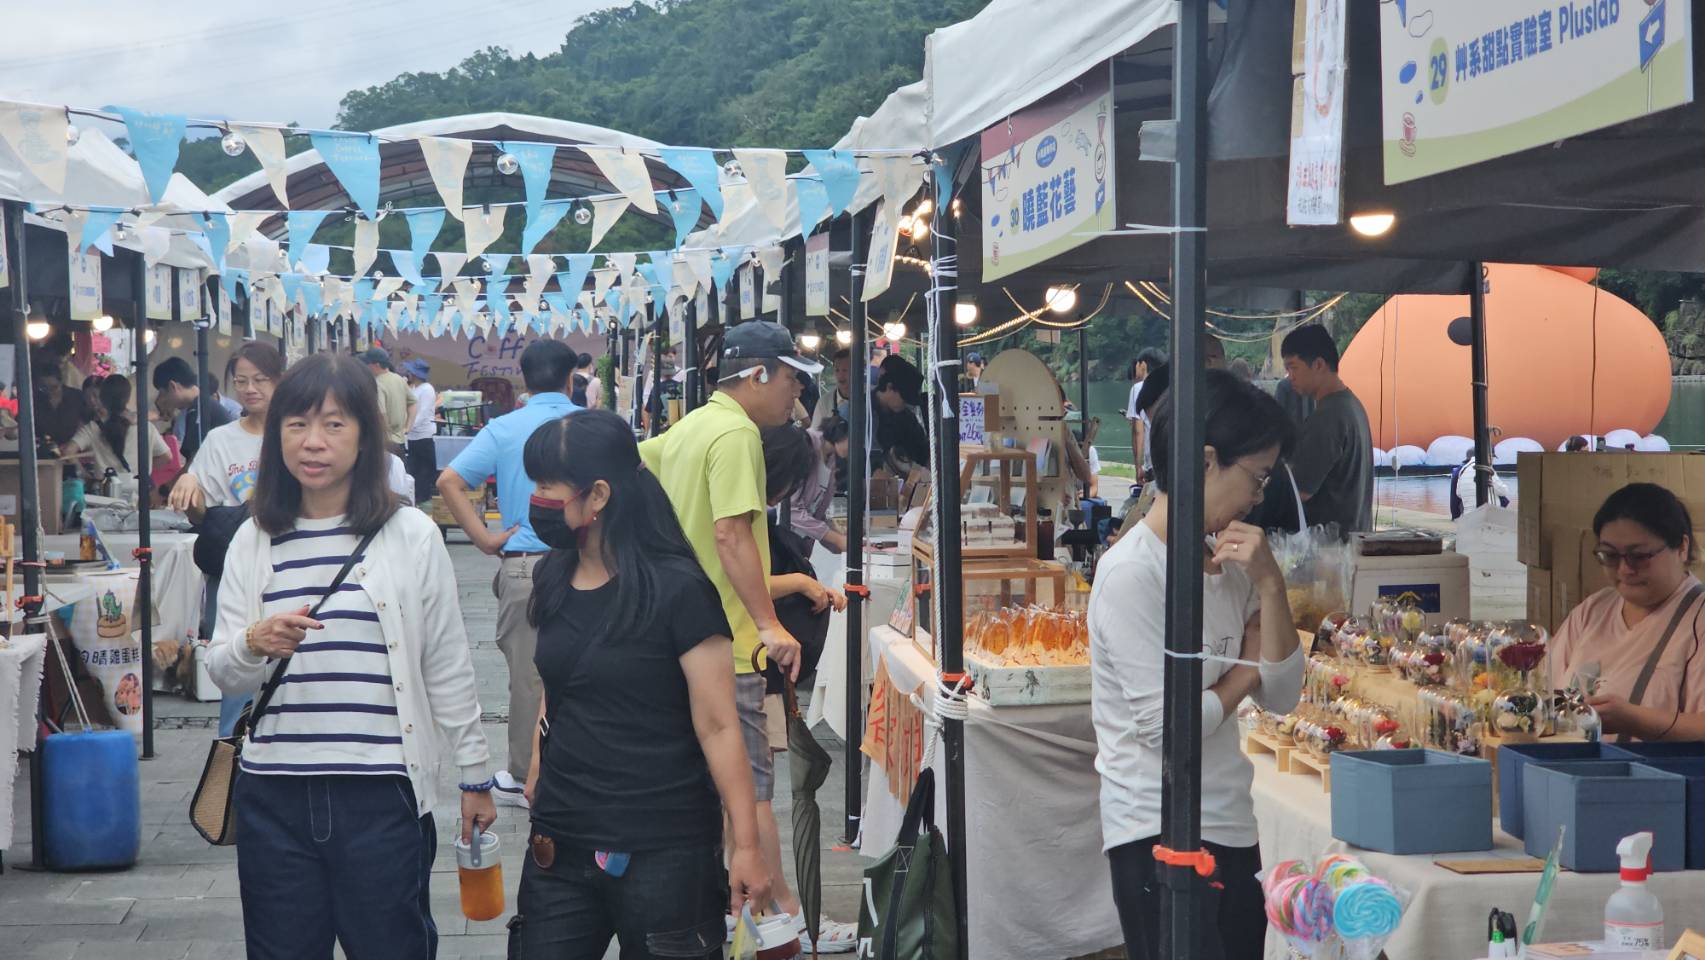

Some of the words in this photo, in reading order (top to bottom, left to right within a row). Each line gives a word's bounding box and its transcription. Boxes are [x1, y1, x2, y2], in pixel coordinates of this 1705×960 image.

[1430, 52, 1447, 90] 29
[1558, 0, 1620, 44] Pluslab
[1010, 207, 1020, 228] 30
[80, 647, 140, 666] 晴雞蛋糕
